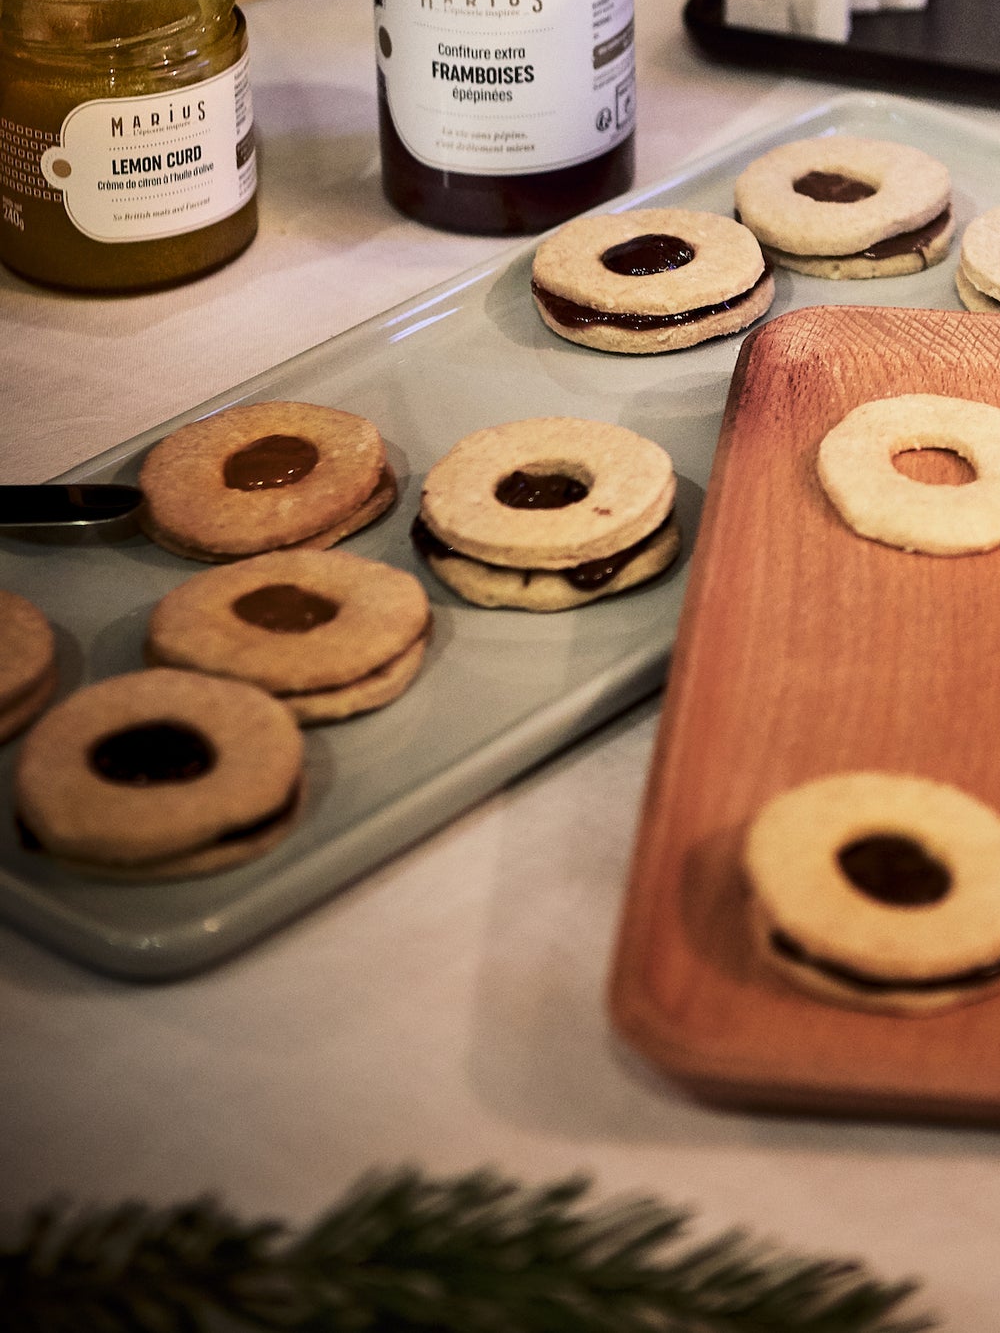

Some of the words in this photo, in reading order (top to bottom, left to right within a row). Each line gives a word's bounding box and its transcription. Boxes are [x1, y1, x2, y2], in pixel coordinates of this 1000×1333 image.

[438, 42, 491, 60] Confiture
[494, 46, 526, 60] extra
[432, 60, 535, 85] FRAMBOISES
[452, 86, 513, 104] épépinées
[112, 154, 161, 175] LEMON
[166, 145, 202, 169] CURD
[97, 179, 124, 191] Crème
[126, 178, 136, 190] de
[138, 175, 161, 188] citron
[163, 173, 169, 184] à
[170, 169, 192, 183] l'huile
[193, 162, 214, 177] d'olive
[124, 211, 151, 221] British
